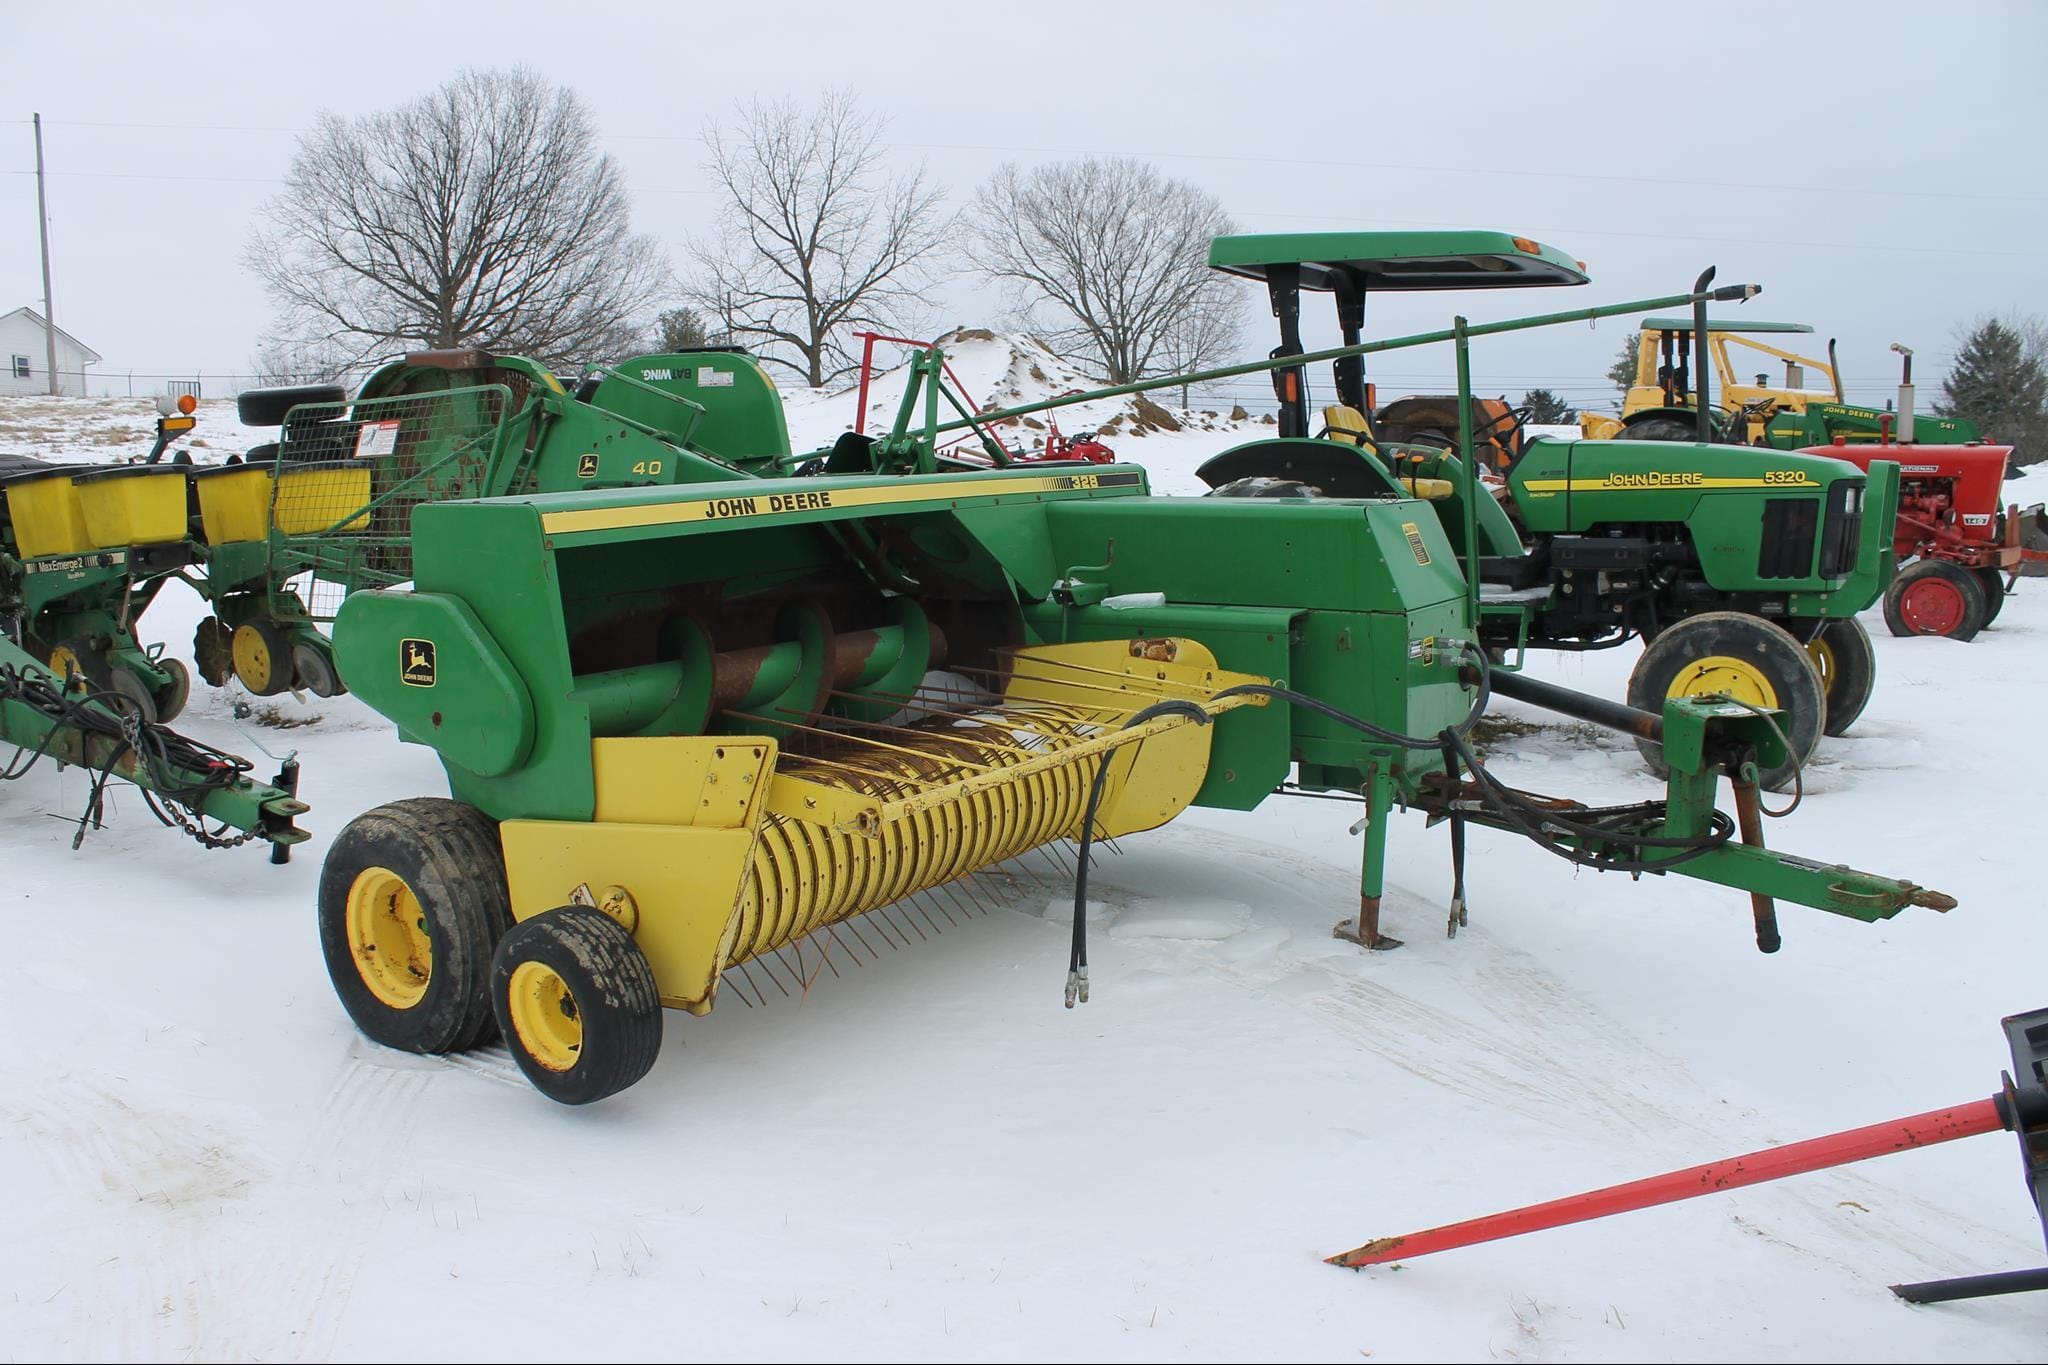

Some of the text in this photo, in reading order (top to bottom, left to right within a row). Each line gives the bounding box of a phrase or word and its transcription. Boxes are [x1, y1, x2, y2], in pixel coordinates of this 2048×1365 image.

[1823, 406, 1875, 419] JOHN DEERE
[1940, 422, 1955, 430] 541
[632, 461, 662, 475] 40
[1071, 475, 1099, 490] 328
[1764, 471, 1806, 483] 5320
[705, 492, 832, 518] JOHN DEERE
